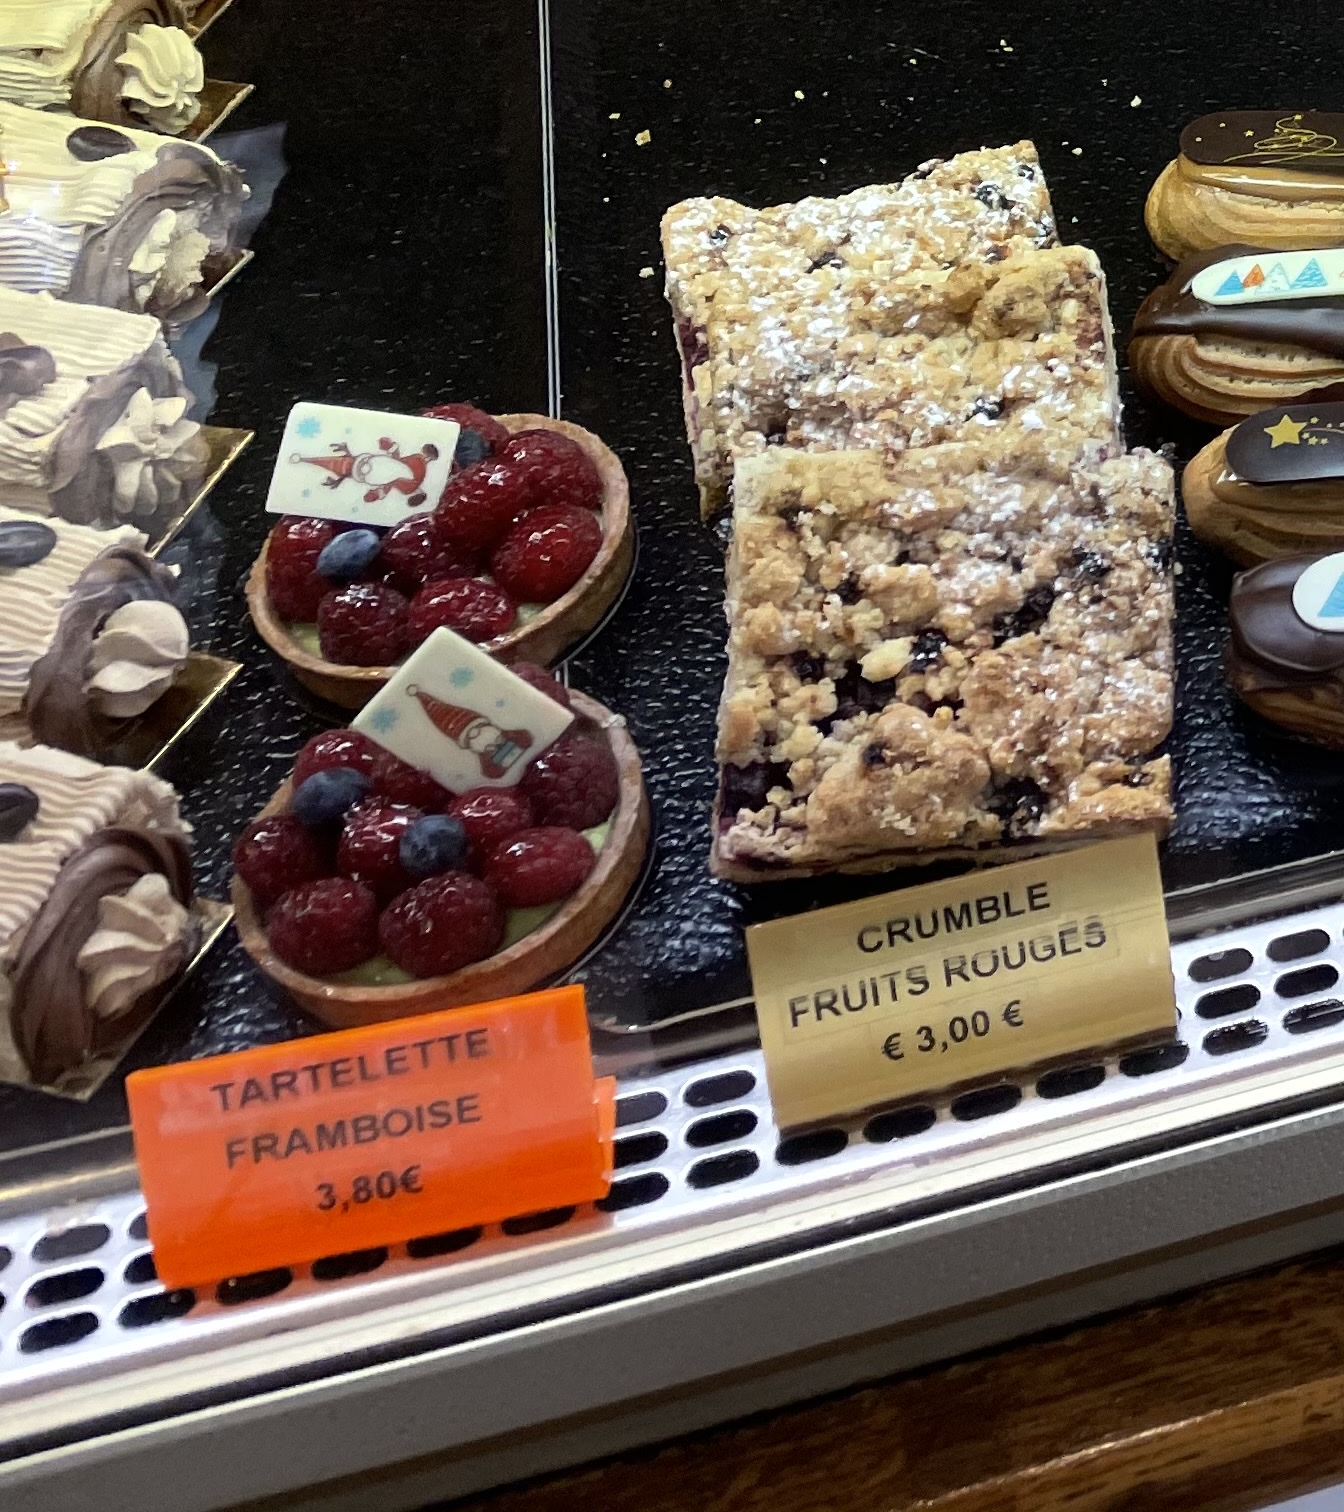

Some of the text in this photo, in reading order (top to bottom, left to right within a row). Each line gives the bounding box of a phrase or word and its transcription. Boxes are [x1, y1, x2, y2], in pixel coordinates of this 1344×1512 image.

[856, 881, 1052, 954] CRUMBLE
[788, 914, 1107, 1029] FRUITS ROUGES
[881, 999, 1025, 1061] € 3,00 €
[210, 1026, 490, 1113] TARTELETTE
[224, 1092, 482, 1170] FRAMBOISE
[315, 1163, 426, 1212] 3,80€
